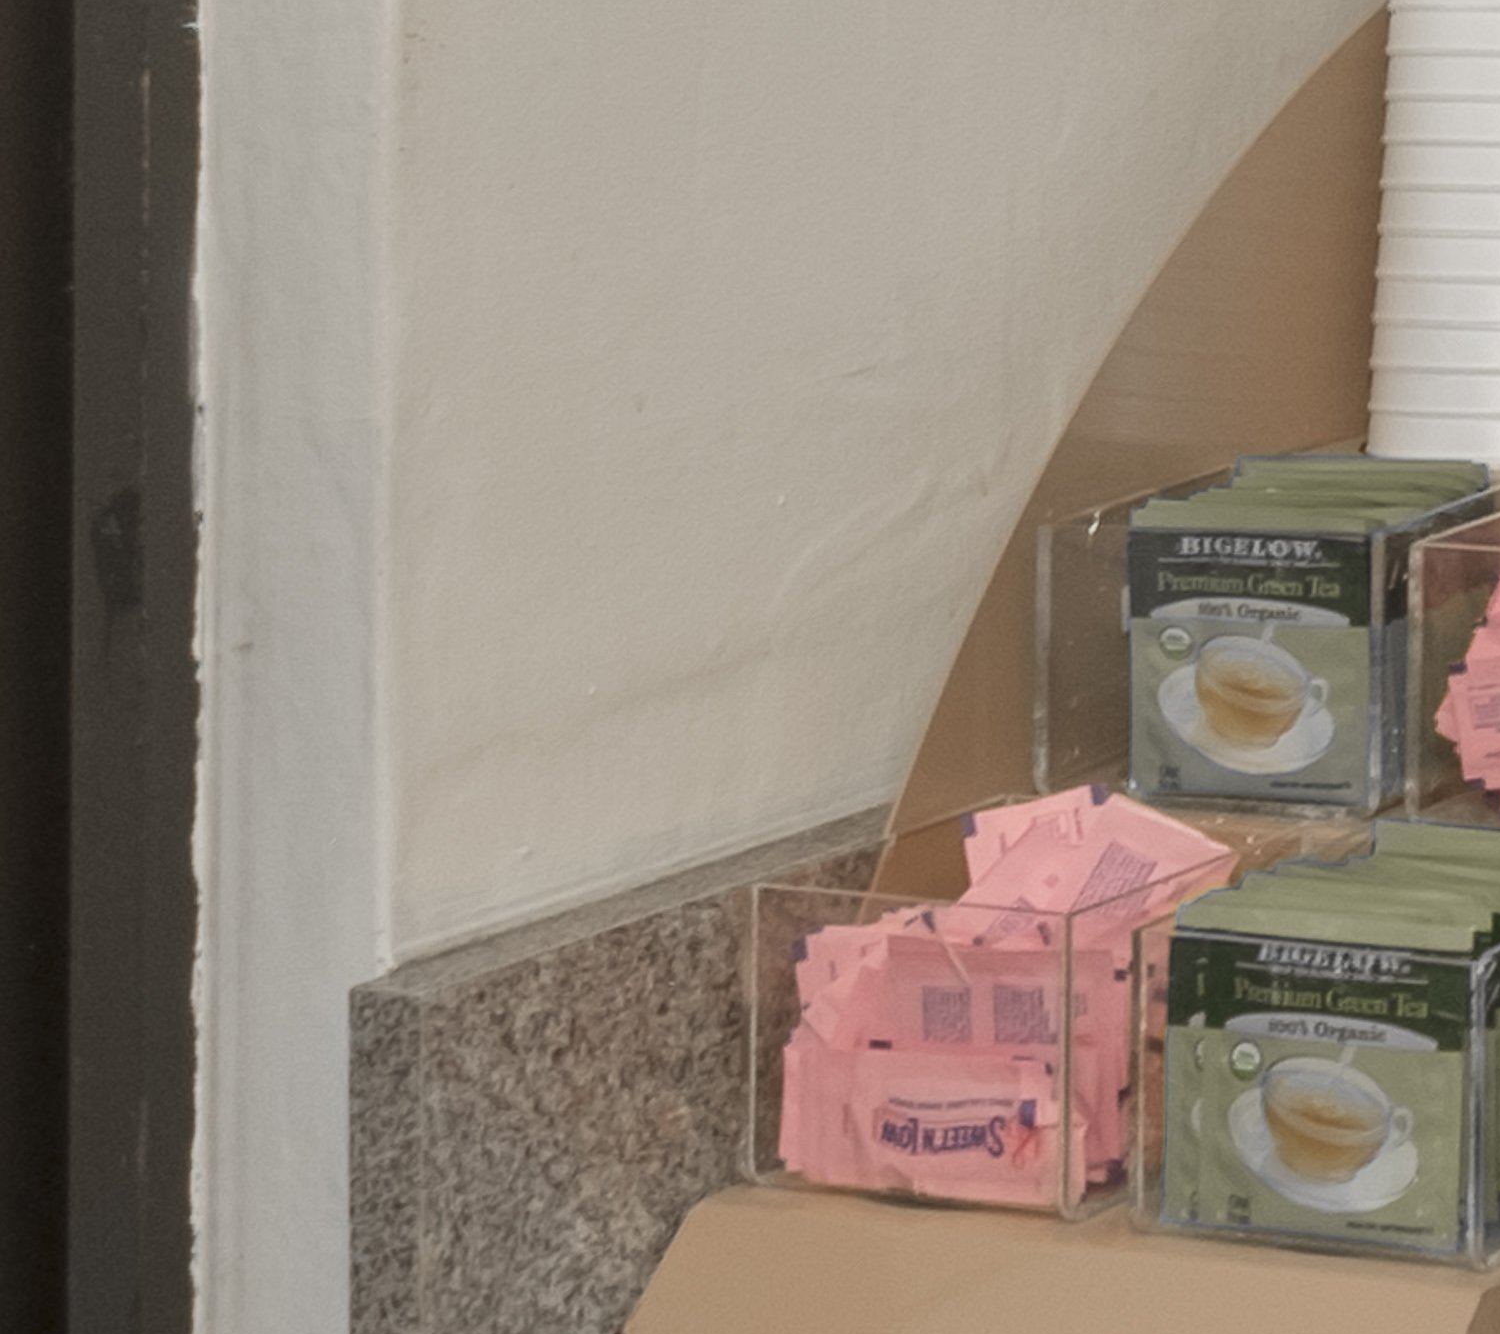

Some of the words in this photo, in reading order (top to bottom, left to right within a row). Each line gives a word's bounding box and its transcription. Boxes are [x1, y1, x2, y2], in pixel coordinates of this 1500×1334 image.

[1179, 535, 1321, 559] BIGELOW
[1157, 571, 1245, 594] Premium
[1248, 572, 1303, 596] Green
[1305, 574, 1341, 599] Tea
[1237, 604, 1300, 622] Organic
[1233, 976, 1323, 1008] Premium
[1325, 988, 1389, 1015] Green
[1391, 991, 1429, 1018] Tea
[1313, 1020, 1388, 1044] Organic
